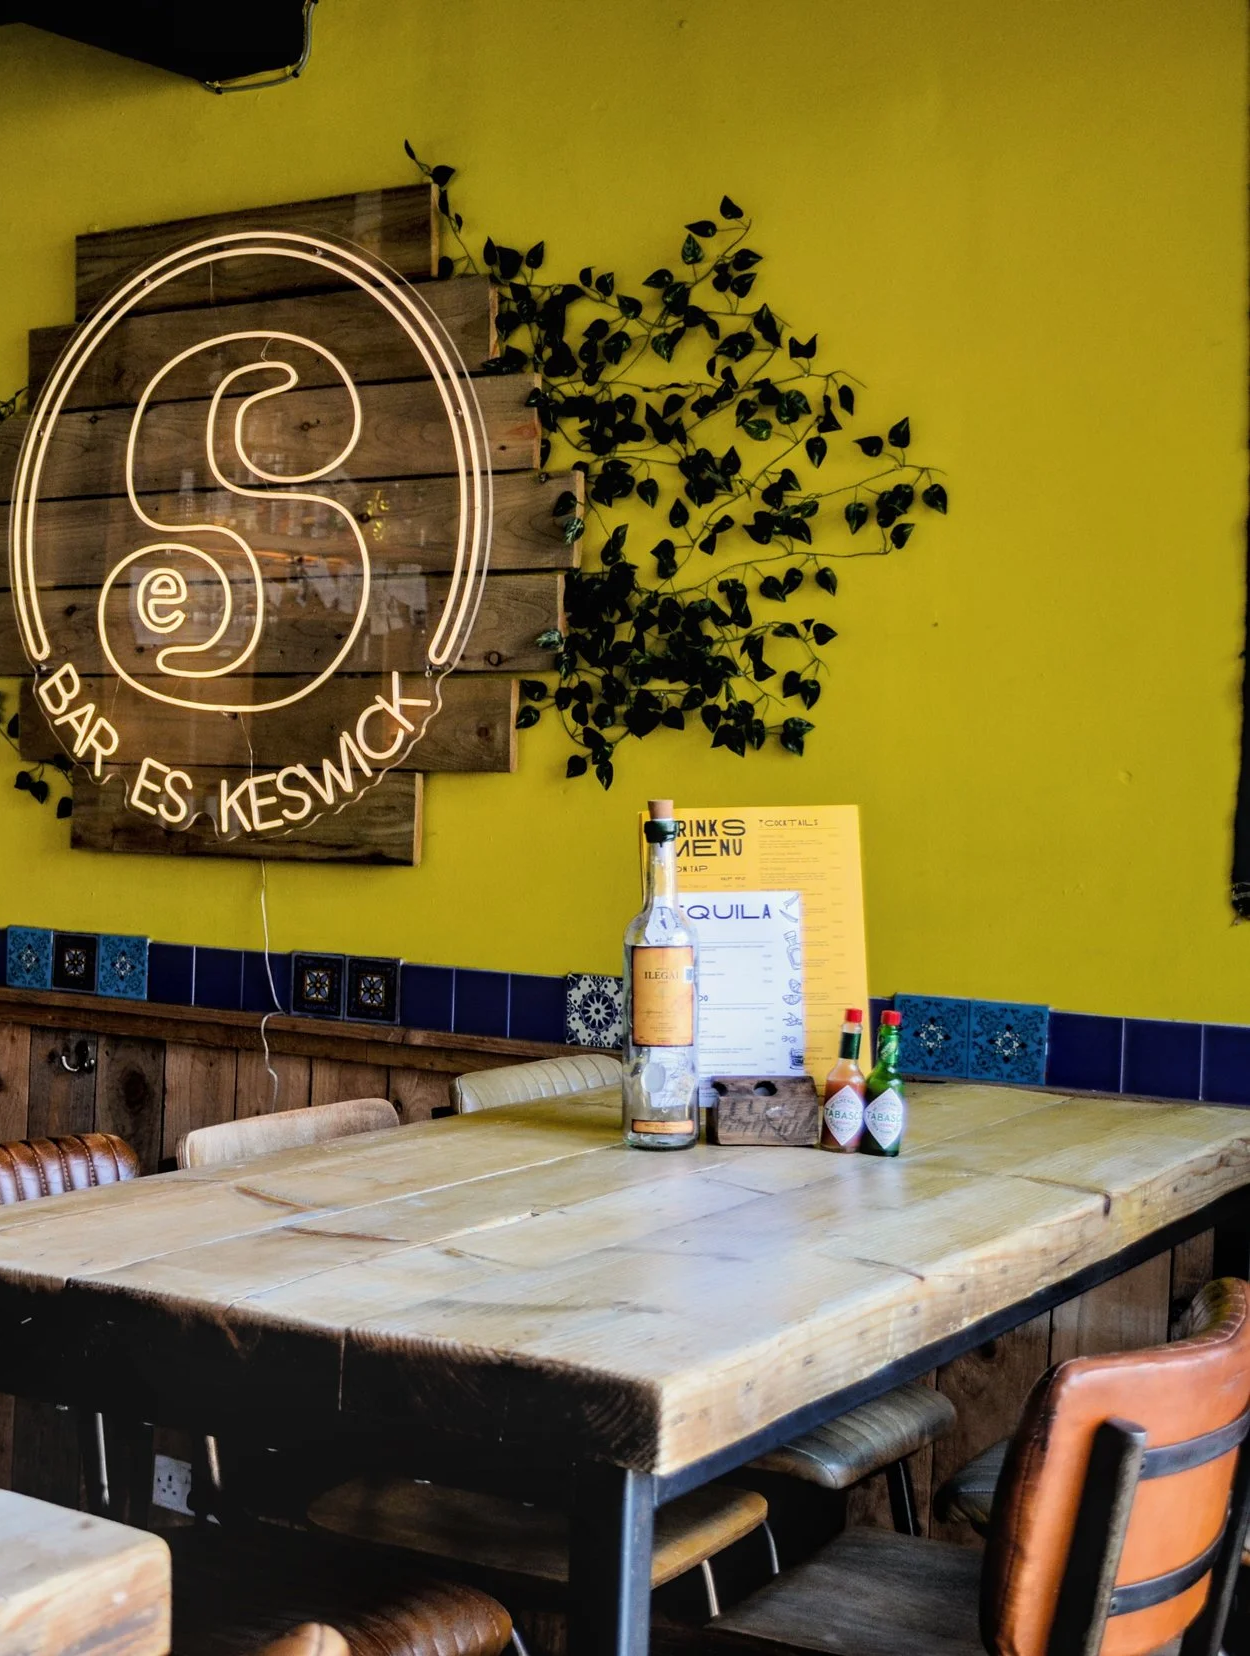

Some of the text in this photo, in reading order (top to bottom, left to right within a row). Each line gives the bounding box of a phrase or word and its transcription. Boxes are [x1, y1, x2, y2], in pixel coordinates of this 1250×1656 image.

[38, 662, 432, 834] BAR ES KESWICK
[677, 818, 747, 838] RINKS
[680, 904, 771, 920] QUILA
[867, 1111, 903, 1124] TABASC
